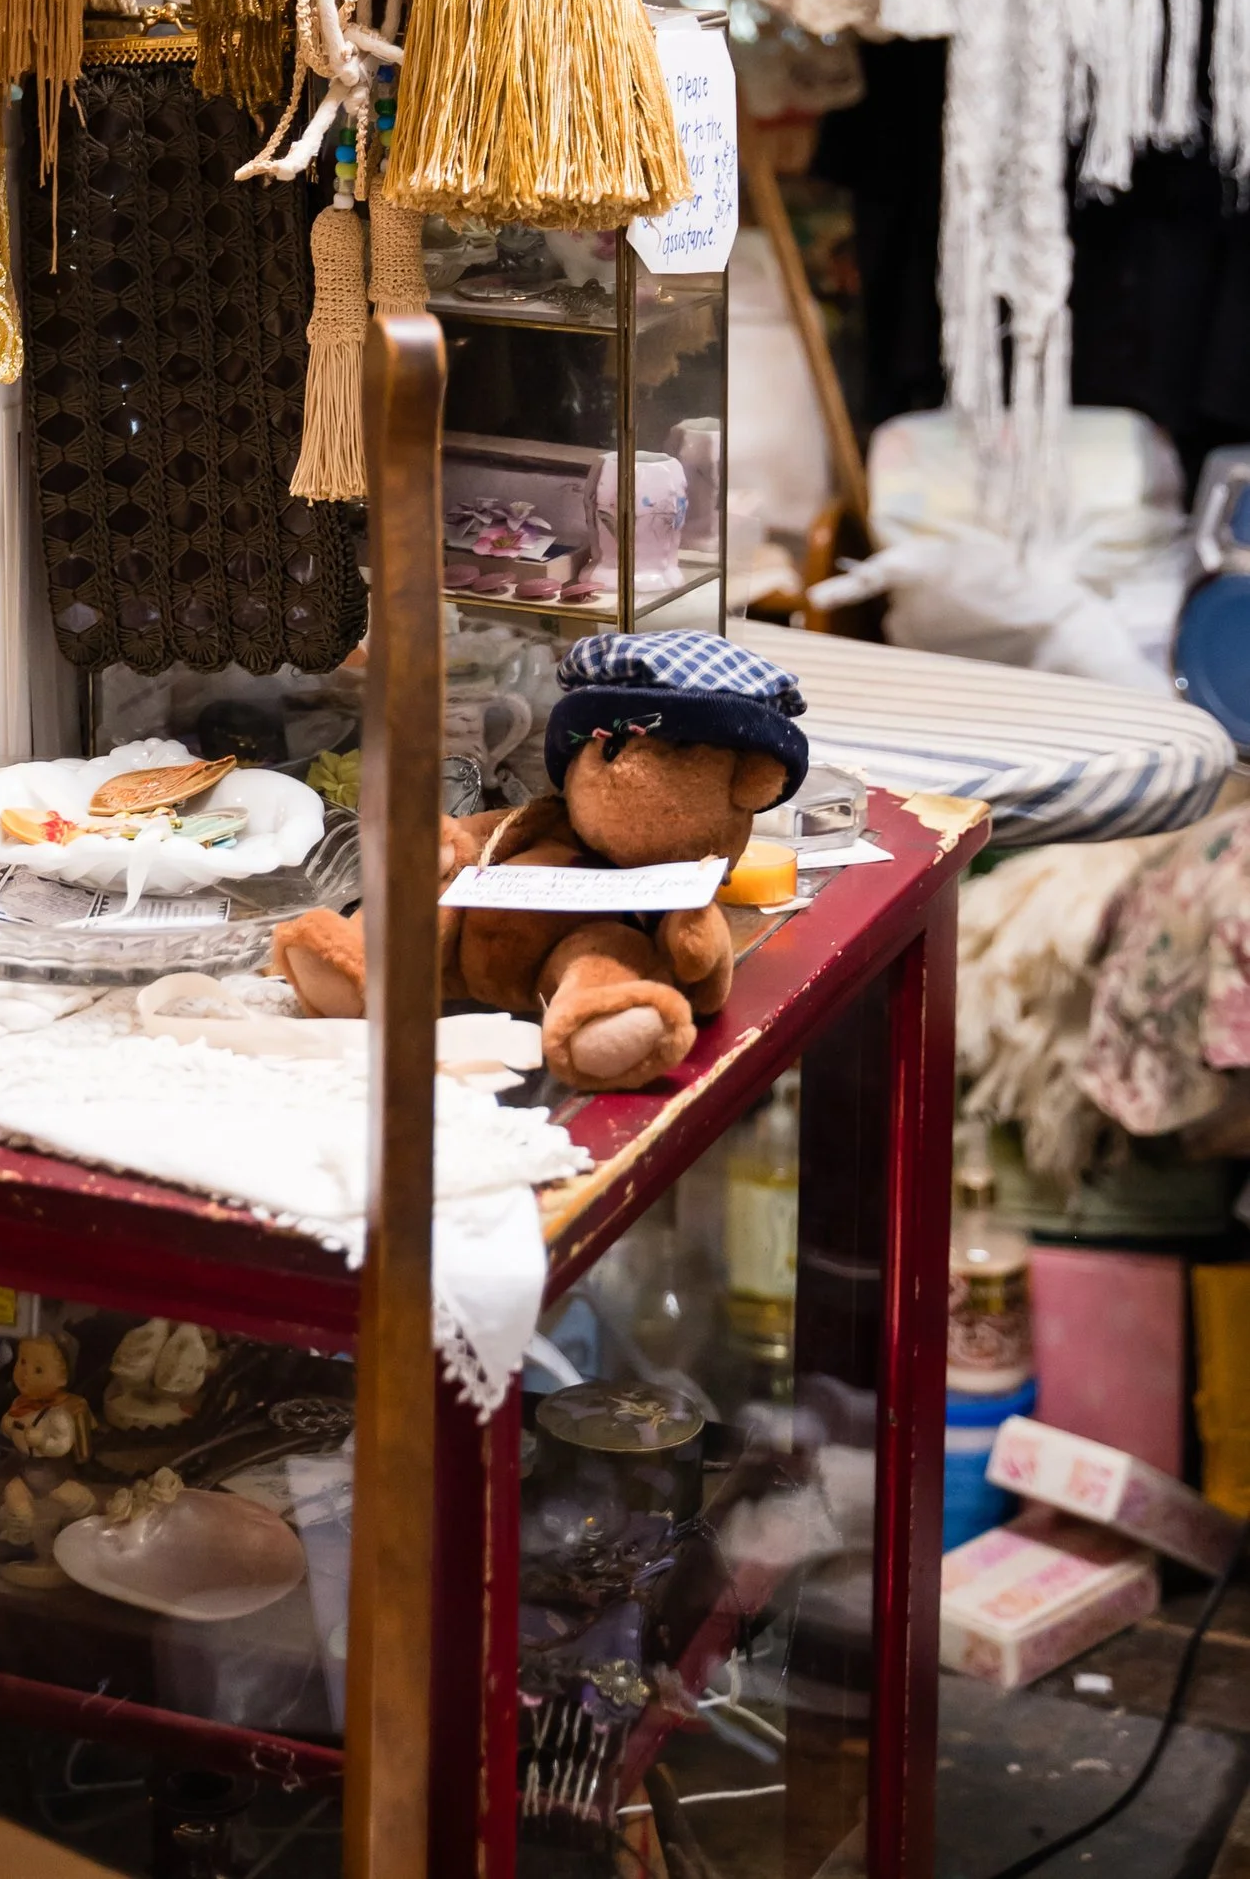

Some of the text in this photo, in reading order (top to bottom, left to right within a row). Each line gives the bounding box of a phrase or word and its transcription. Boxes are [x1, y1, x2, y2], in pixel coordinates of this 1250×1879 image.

[676, 71, 709, 107] Please
[693, 118, 705, 150] to
[706, 113, 723, 146] the
